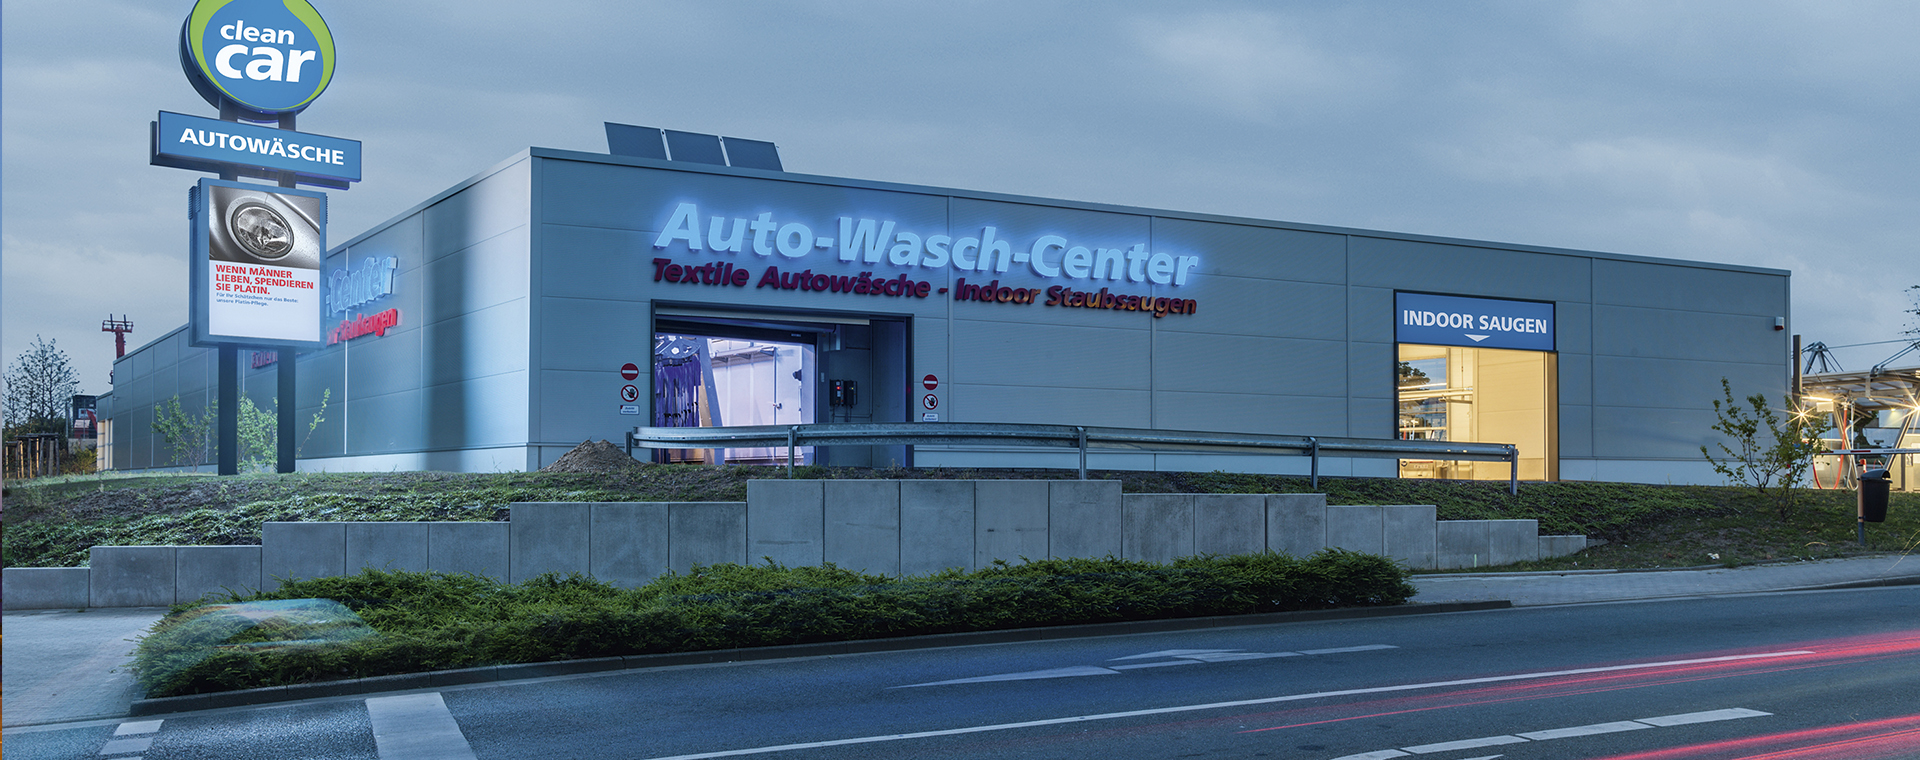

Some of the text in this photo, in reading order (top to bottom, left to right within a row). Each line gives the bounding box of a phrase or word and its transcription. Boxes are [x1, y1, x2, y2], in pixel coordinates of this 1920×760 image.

[220, 20, 295, 45] clean
[215, 44, 316, 82] car
[179, 128, 344, 165] AUTOWÄSCHE
[653, 203, 1198, 286] Auto-Wasch-Center
[215, 264, 293, 279] WENN MÄNNER
[216, 274, 314, 289] LIEBEN, SPENDIEREN
[215, 283, 270, 295] SIE PLATIN.
[653, 257, 750, 286] Textile
[757, 266, 931, 298] Autowäsche
[956, 278, 1041, 305] Indoor
[1046, 285, 1198, 318] Staubsaugen
[1403, 310, 1547, 334] INDOOR SAUGEN
